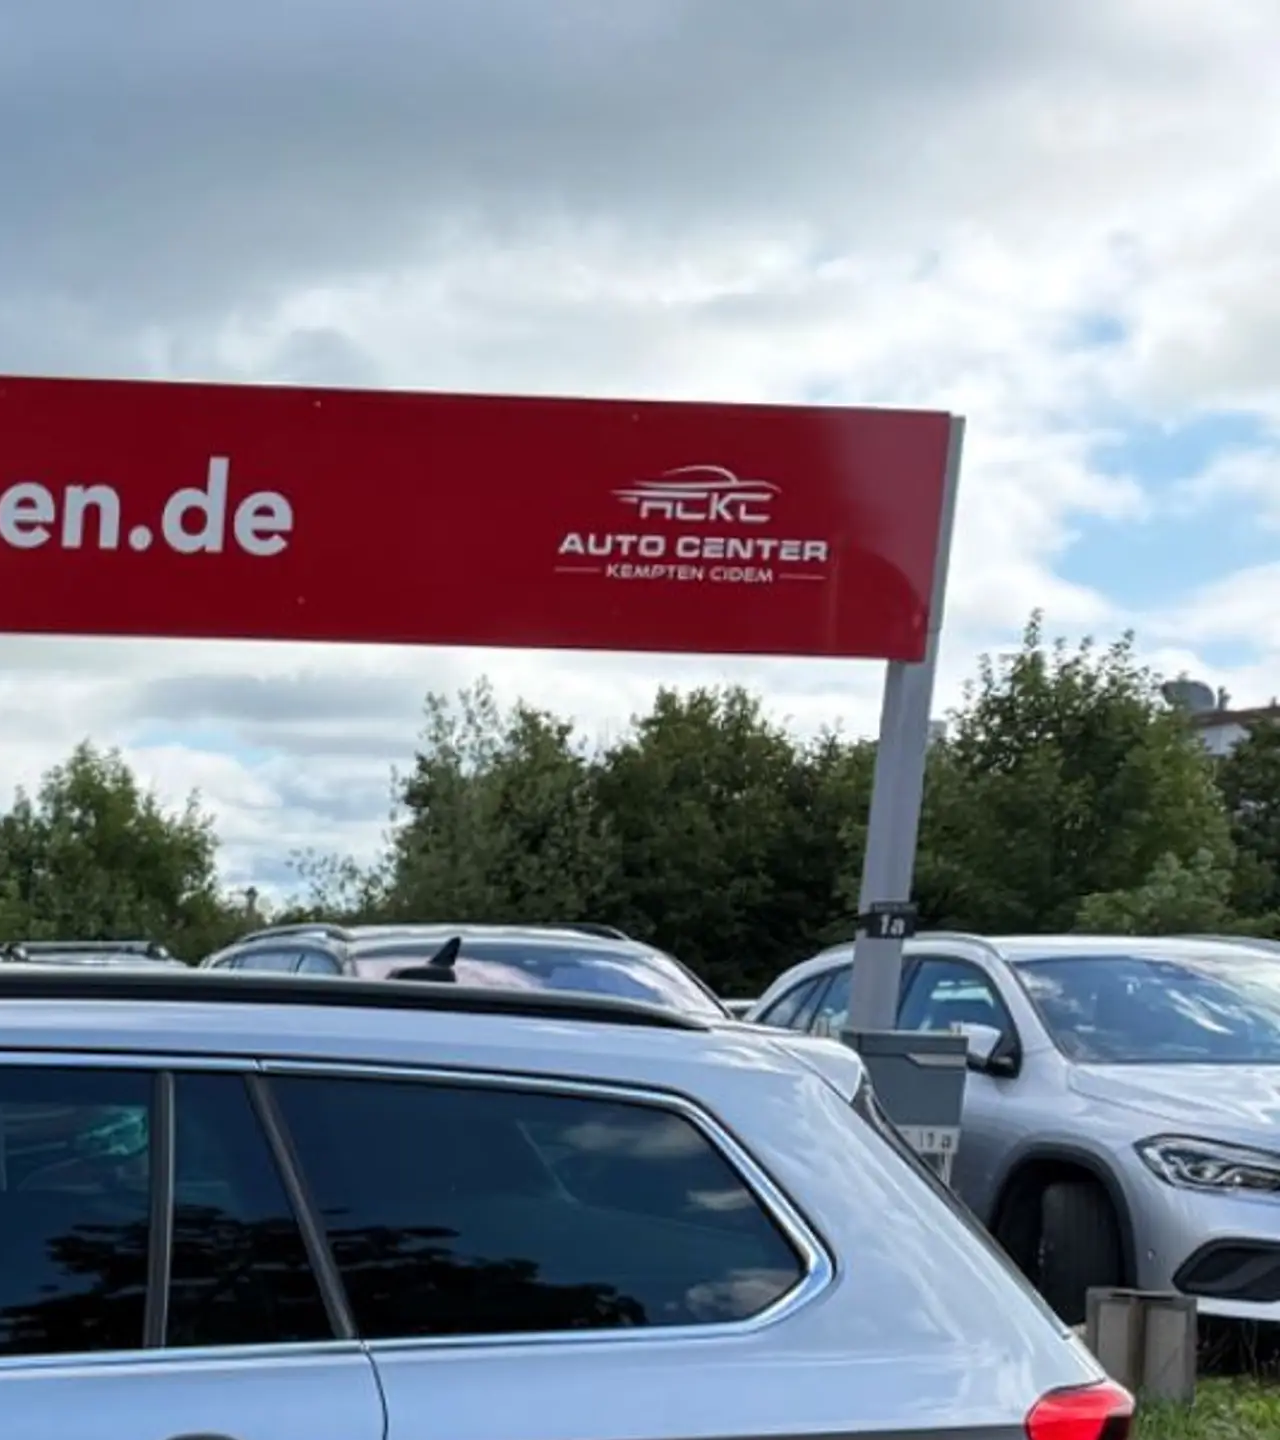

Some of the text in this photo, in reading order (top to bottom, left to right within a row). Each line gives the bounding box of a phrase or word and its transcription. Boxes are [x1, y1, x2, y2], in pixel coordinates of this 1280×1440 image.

[558, 533, 828, 562] AUTO CENTER
[606, 563, 773, 583] KEMPTEN CIDEM
